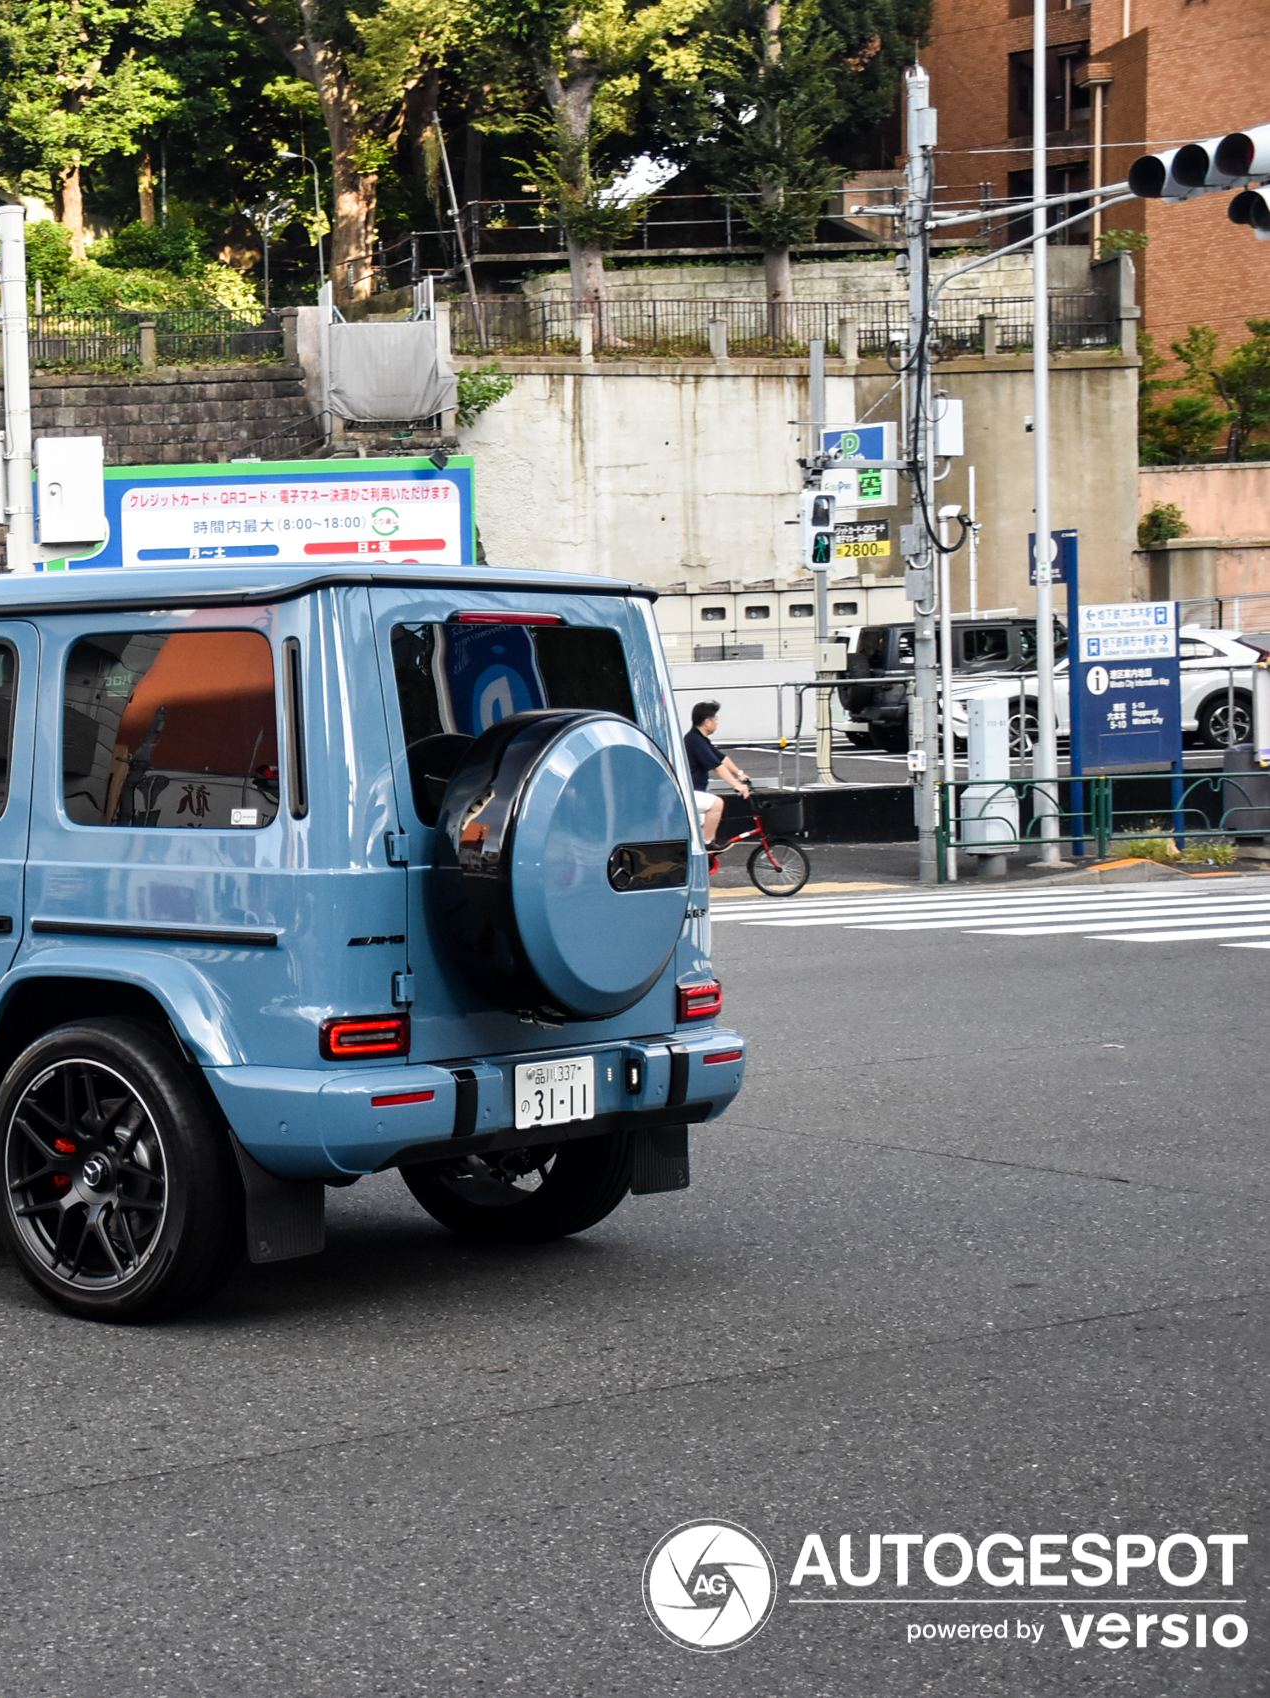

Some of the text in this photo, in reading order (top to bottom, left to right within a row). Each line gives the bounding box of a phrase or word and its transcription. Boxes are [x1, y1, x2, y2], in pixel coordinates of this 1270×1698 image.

[357, 541, 391, 553] 日・祝
[534, 1084, 586, 1120] 31-11
